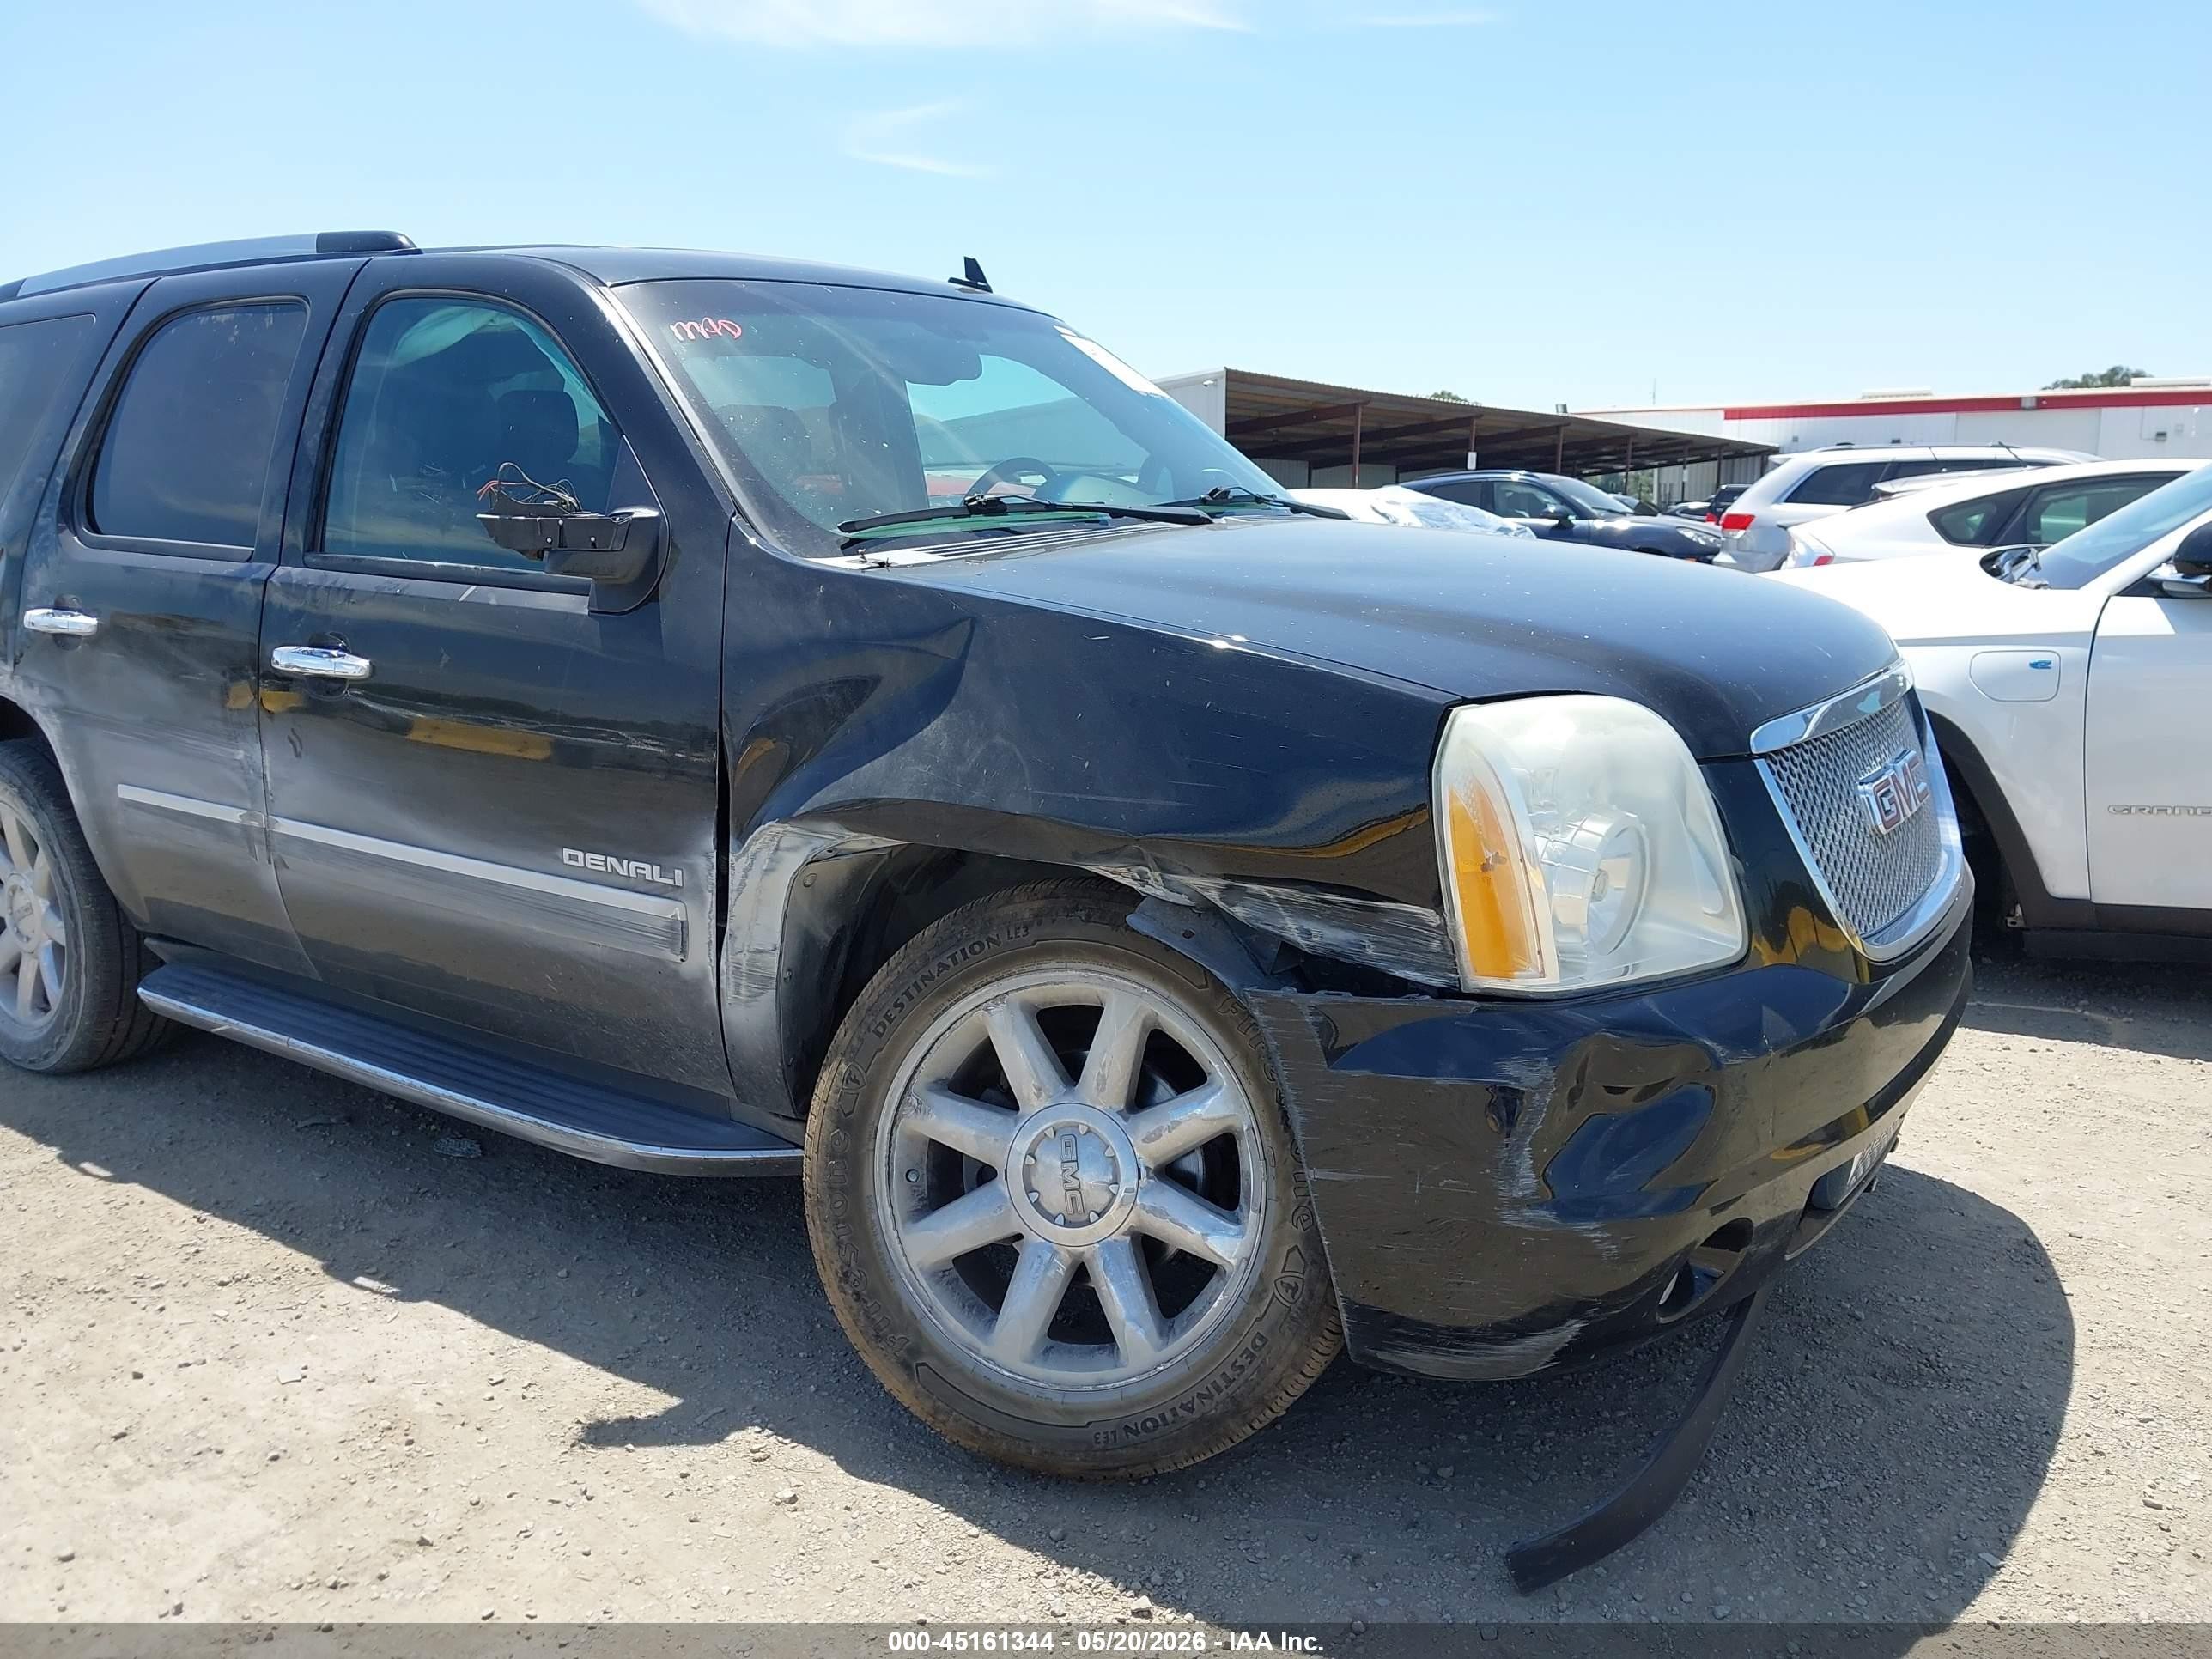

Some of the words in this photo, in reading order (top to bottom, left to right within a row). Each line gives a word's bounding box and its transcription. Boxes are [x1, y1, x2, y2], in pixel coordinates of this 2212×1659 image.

[1869, 750, 1929, 834] GMC
[562, 847, 684, 887] DENALI
[872, 933, 1002, 1038] DESTINATION
[1006, 926, 1030, 941] LE3
[1060, 1133, 1085, 1214] GMC
[825, 1127, 910, 1358] Firestone
[1122, 1332, 1269, 1439] DESTINATION
[1093, 1431, 1117, 1444] LE3
